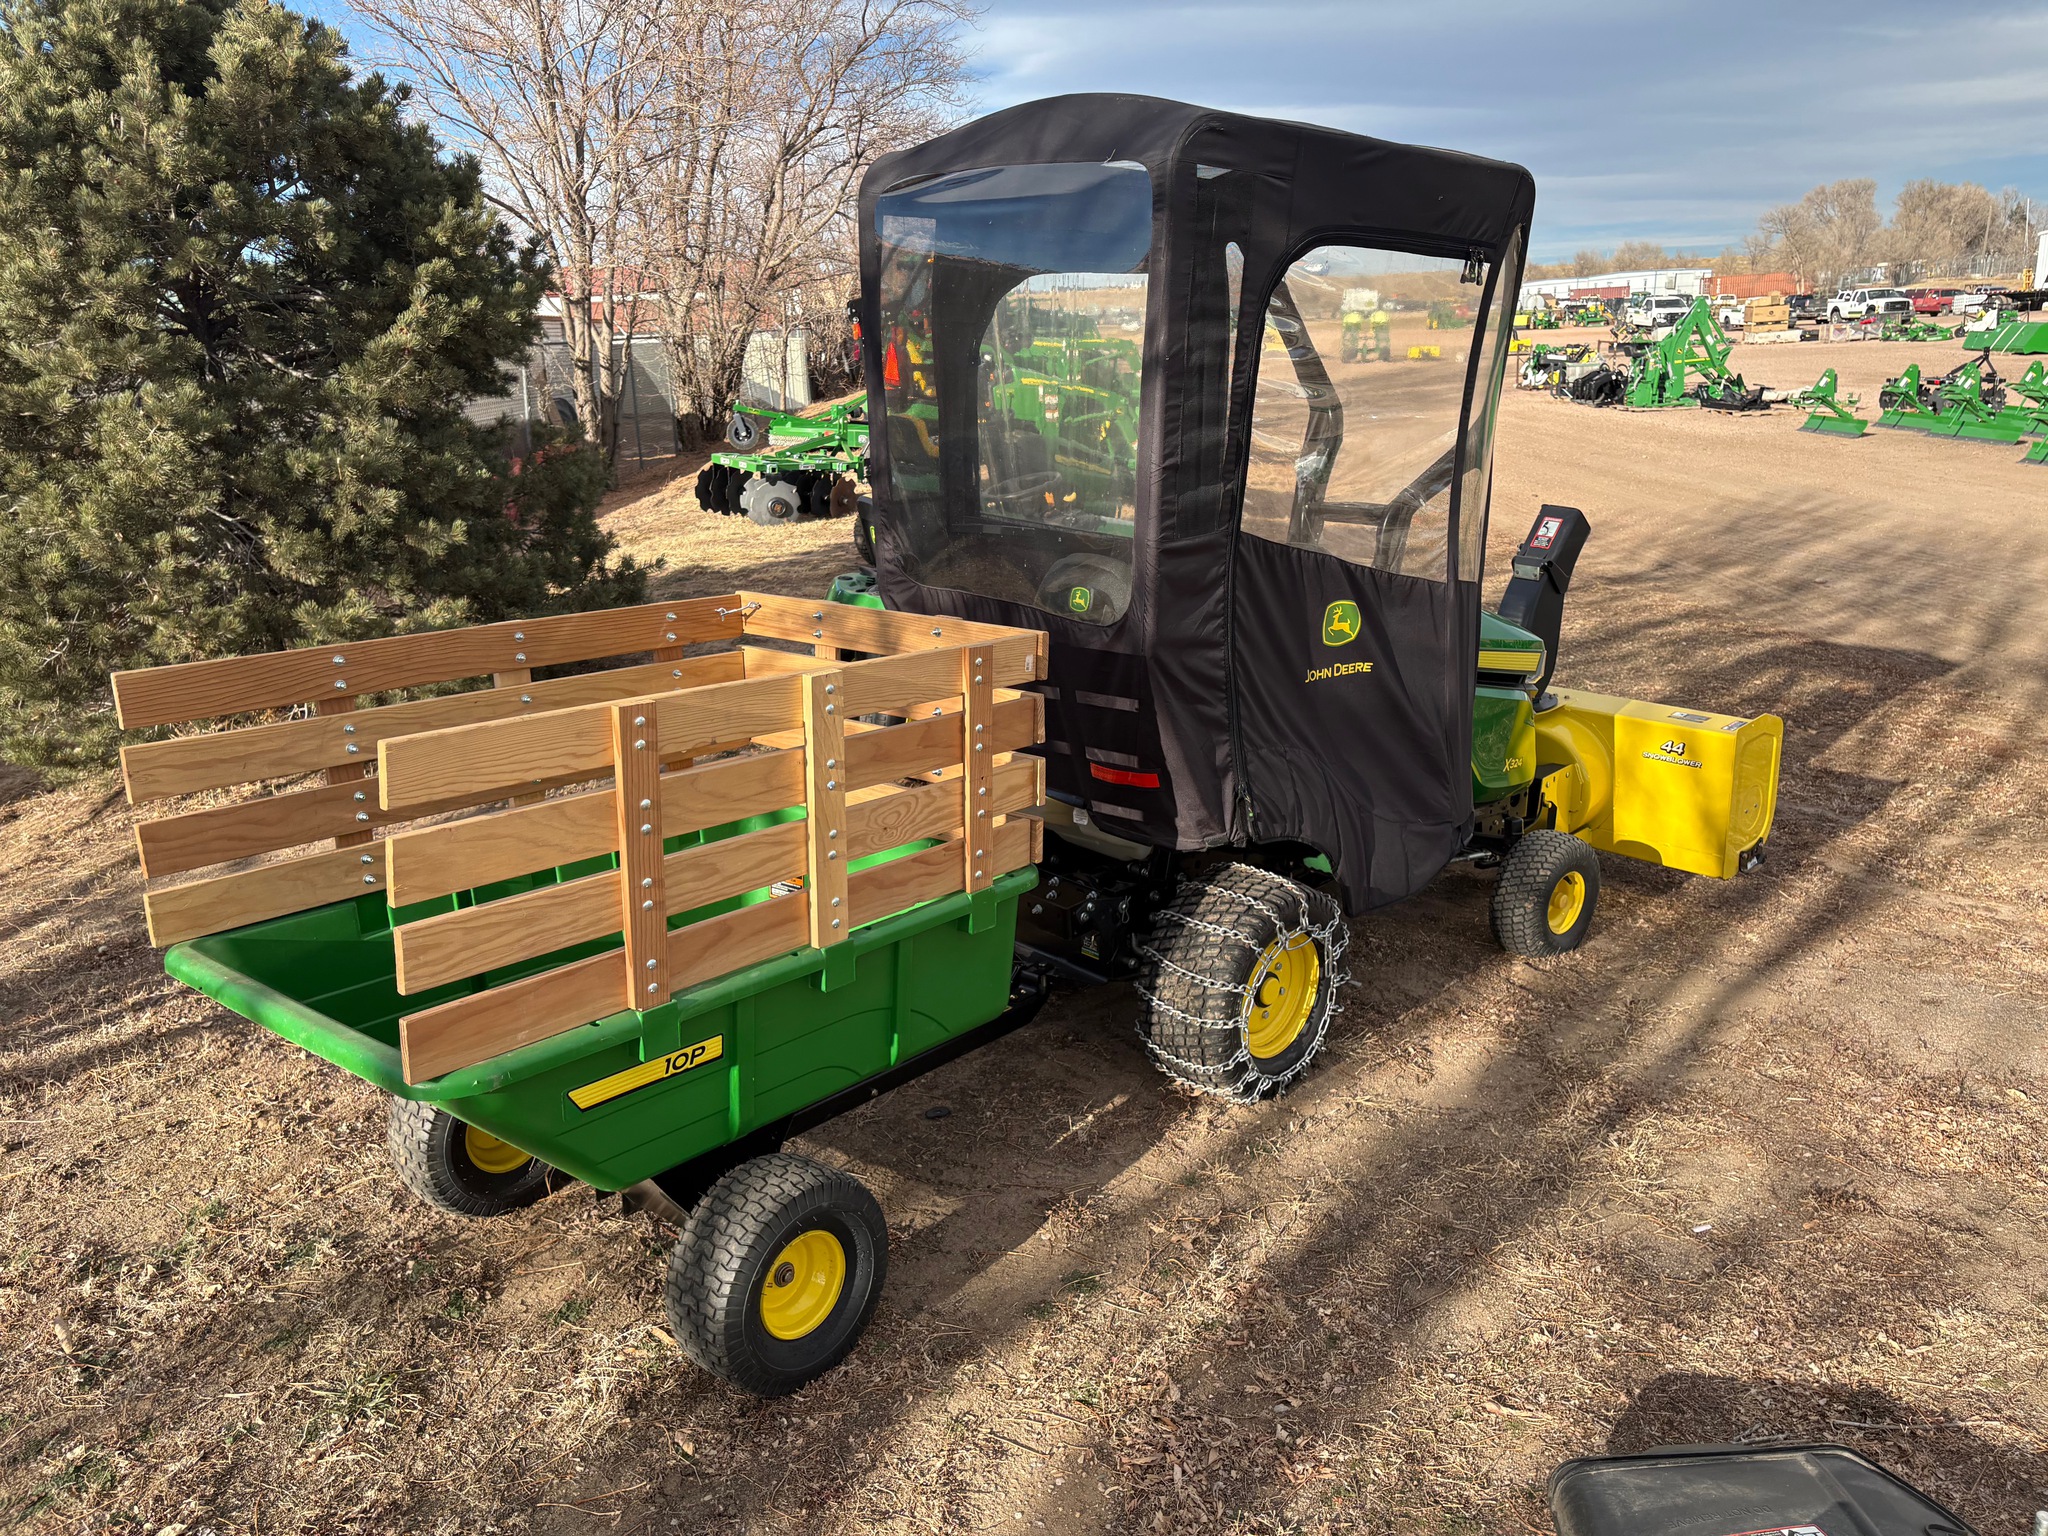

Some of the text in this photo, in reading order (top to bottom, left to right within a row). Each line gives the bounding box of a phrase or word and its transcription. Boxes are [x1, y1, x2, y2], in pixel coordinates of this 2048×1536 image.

[1304, 662, 1374, 683] JOHN DEERE
[1660, 740, 1686, 756] 44
[1503, 757, 1523, 772] X324
[1642, 751, 1703, 769] SNOWBLOWER
[664, 1045, 707, 1076] 10P
[1668, 1504, 1774, 1530] DO NOT REMOVE
